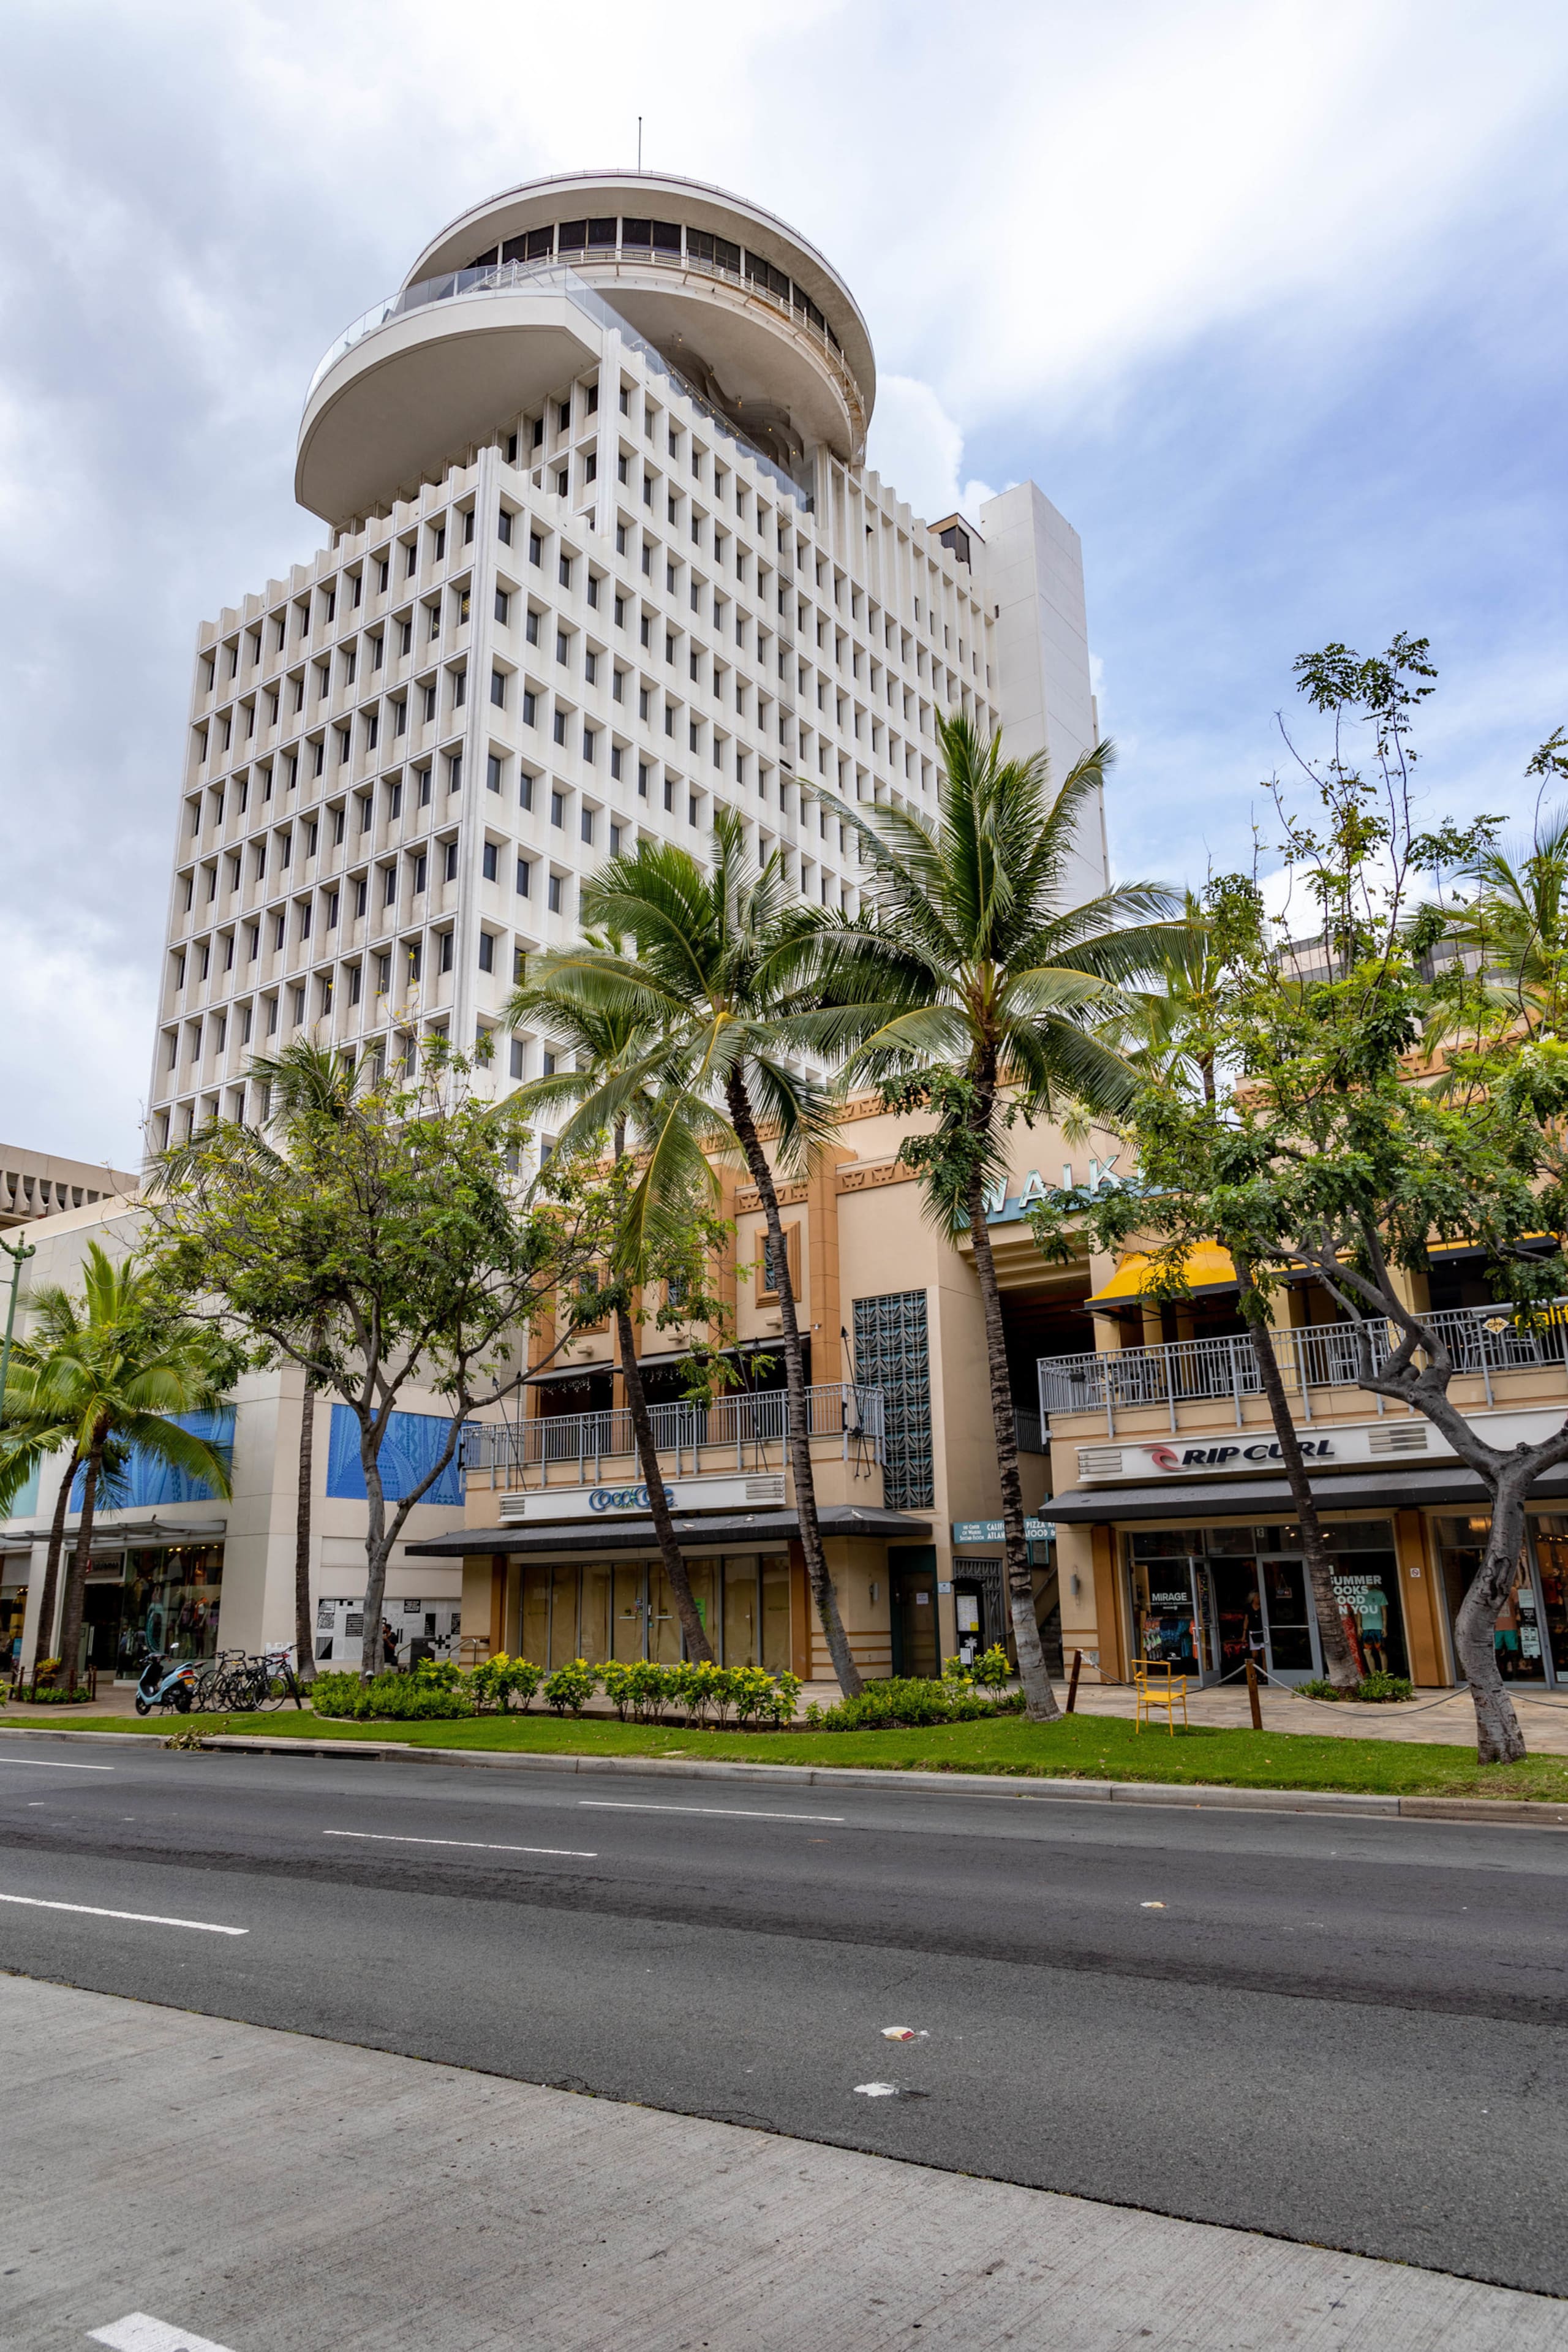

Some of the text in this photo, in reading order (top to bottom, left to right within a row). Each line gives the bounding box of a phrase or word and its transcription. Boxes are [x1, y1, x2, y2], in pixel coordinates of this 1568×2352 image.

[1182, 1439, 1335, 1465] RIP CURL
[1025, 1529, 1048, 1538] FOOD
[1333, 1585, 1369, 1595] OOKS
[1152, 1592, 1188, 1601] MIRAGE
[1335, 1595, 1366, 1605] OOD
[1338, 1605, 1379, 1615] N YOU
